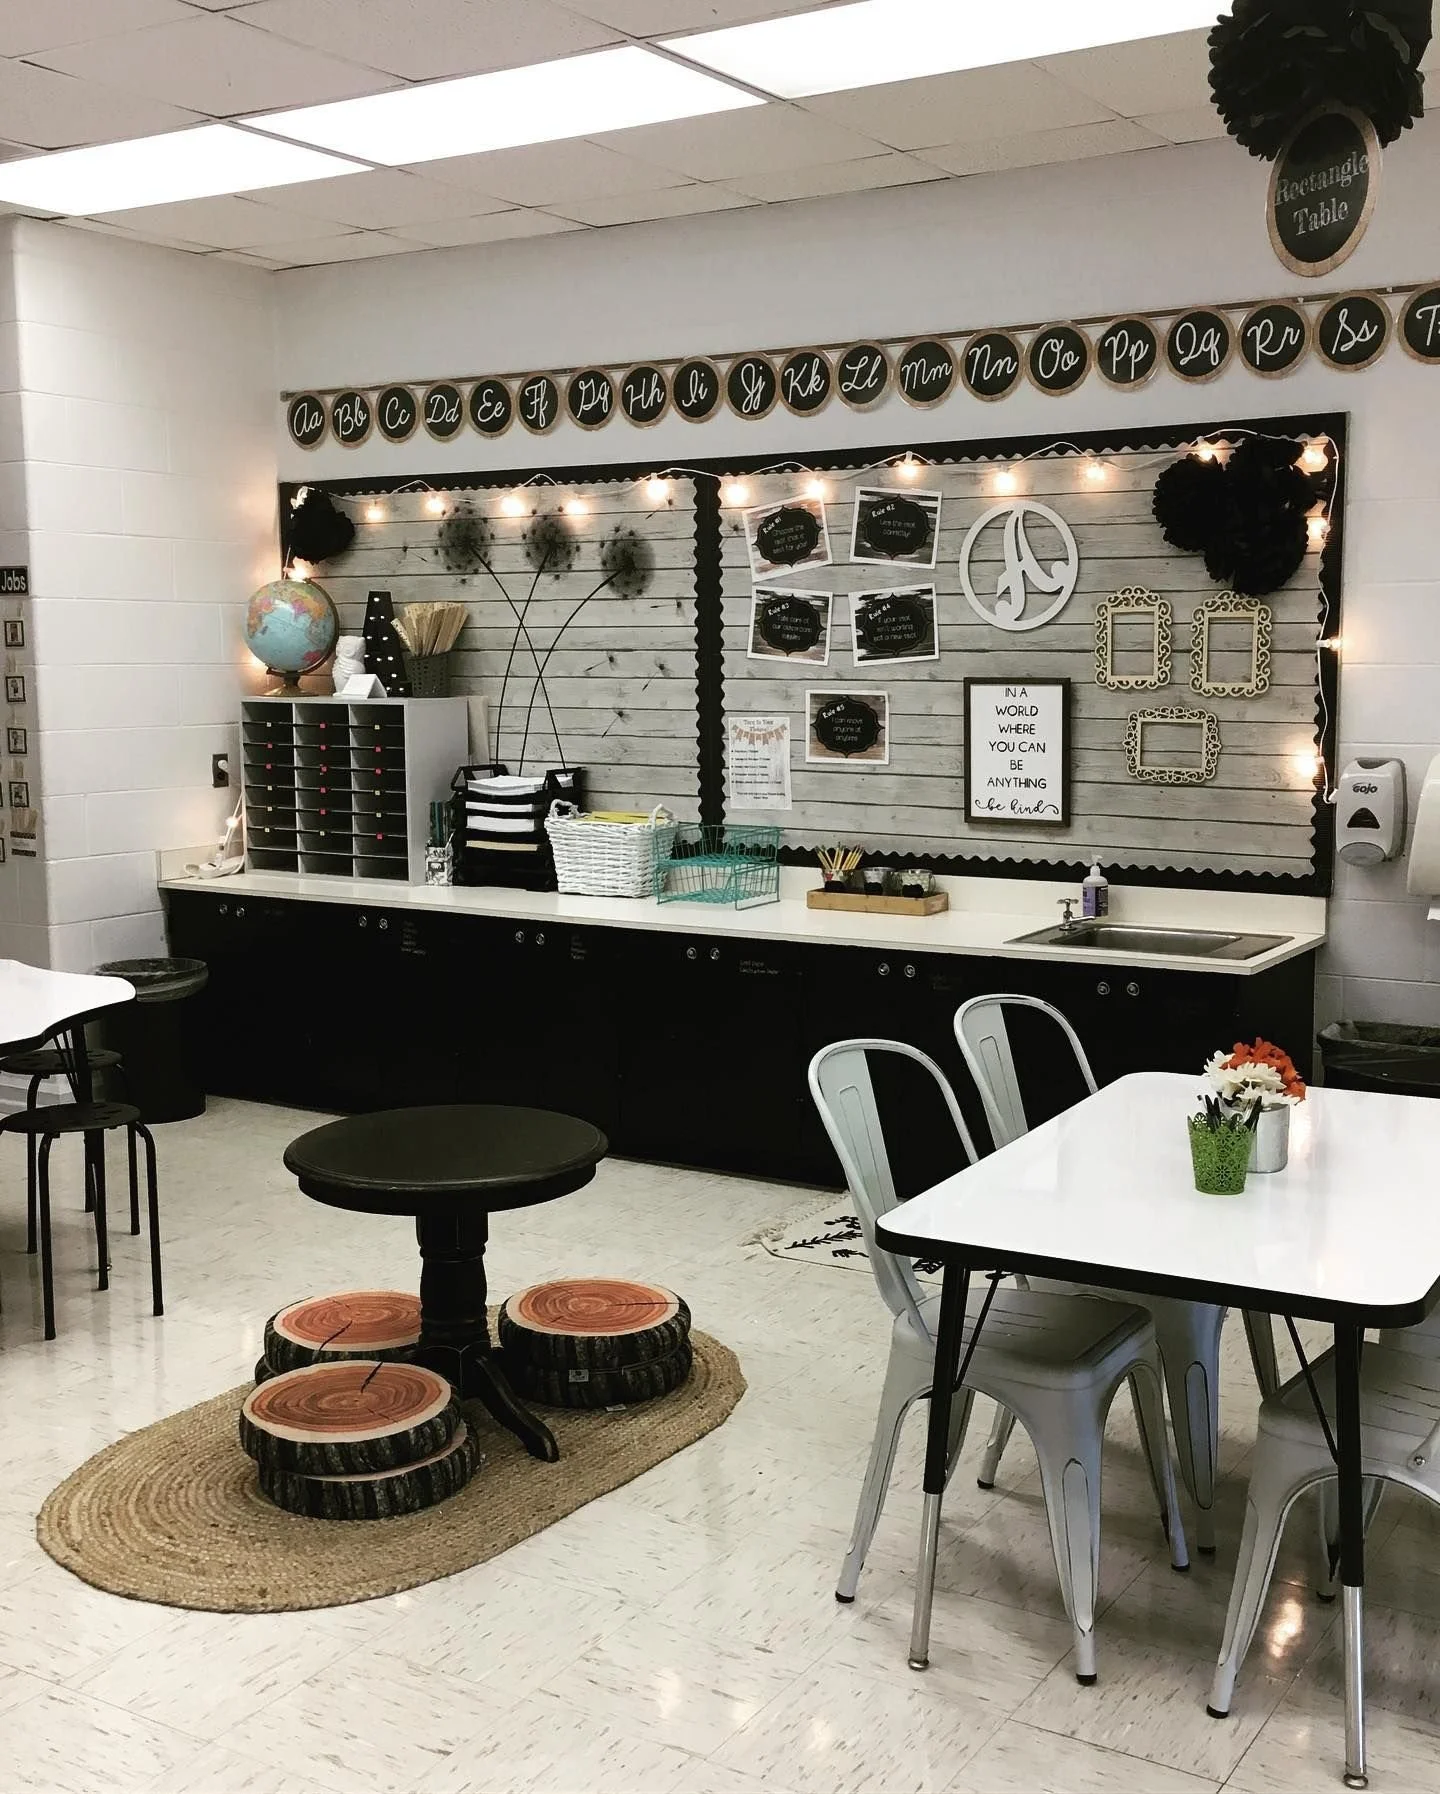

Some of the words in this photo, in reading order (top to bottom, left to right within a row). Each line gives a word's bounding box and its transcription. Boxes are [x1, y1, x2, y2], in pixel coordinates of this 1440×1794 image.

[1275, 151, 1369, 206] Rectangle
[1293, 197, 1348, 236] Table
[1247, 319, 1299, 365] Rr
[1332, 308, 1378, 354] Ss
[1415, 305, 1440, 347] T
[1039, 338, 1079, 379] Oo
[1104, 330, 1149, 379] Pp
[1175, 322, 1220, 366] Qq
[784, 357, 825, 403] Kk
[841, 355, 882, 393] Ll
[902, 358, 952, 392] Mm
[968, 344, 1018, 385] Nn
[477, 388, 505, 421] Ee
[525, 379, 547, 428] Ff
[577, 370, 610, 418] Gg
[625, 373, 664, 414] Hh
[682, 368, 708, 407] Ii
[740, 363, 764, 413] Jj
[294, 403, 323, 437] Aa
[335, 397, 367, 438] Bb
[385, 396, 410, 430] Cc
[426, 395, 459, 424] Dd
[762, 522, 775, 534] Rule
[872, 508, 885, 518] Rule
[1, 570, 26, 591] Jobs
[768, 606, 781, 616] Rule
[868, 609, 881, 620] Rule
[1005, 687, 1016, 698] IN
[1019, 687, 1028, 698] A
[822, 708, 836, 719] Rule
[995, 704, 1039, 717] WORLD
[998, 723, 1036, 735] WHERE
[988, 741, 1015, 753] YOU
[1018, 741, 1046, 754] CAN
[1009, 759, 1024, 771] BE
[986, 777, 1047, 789] ANYTHING
[974, 797, 1006, 812] be
[1010, 798, 1059, 815] kind
